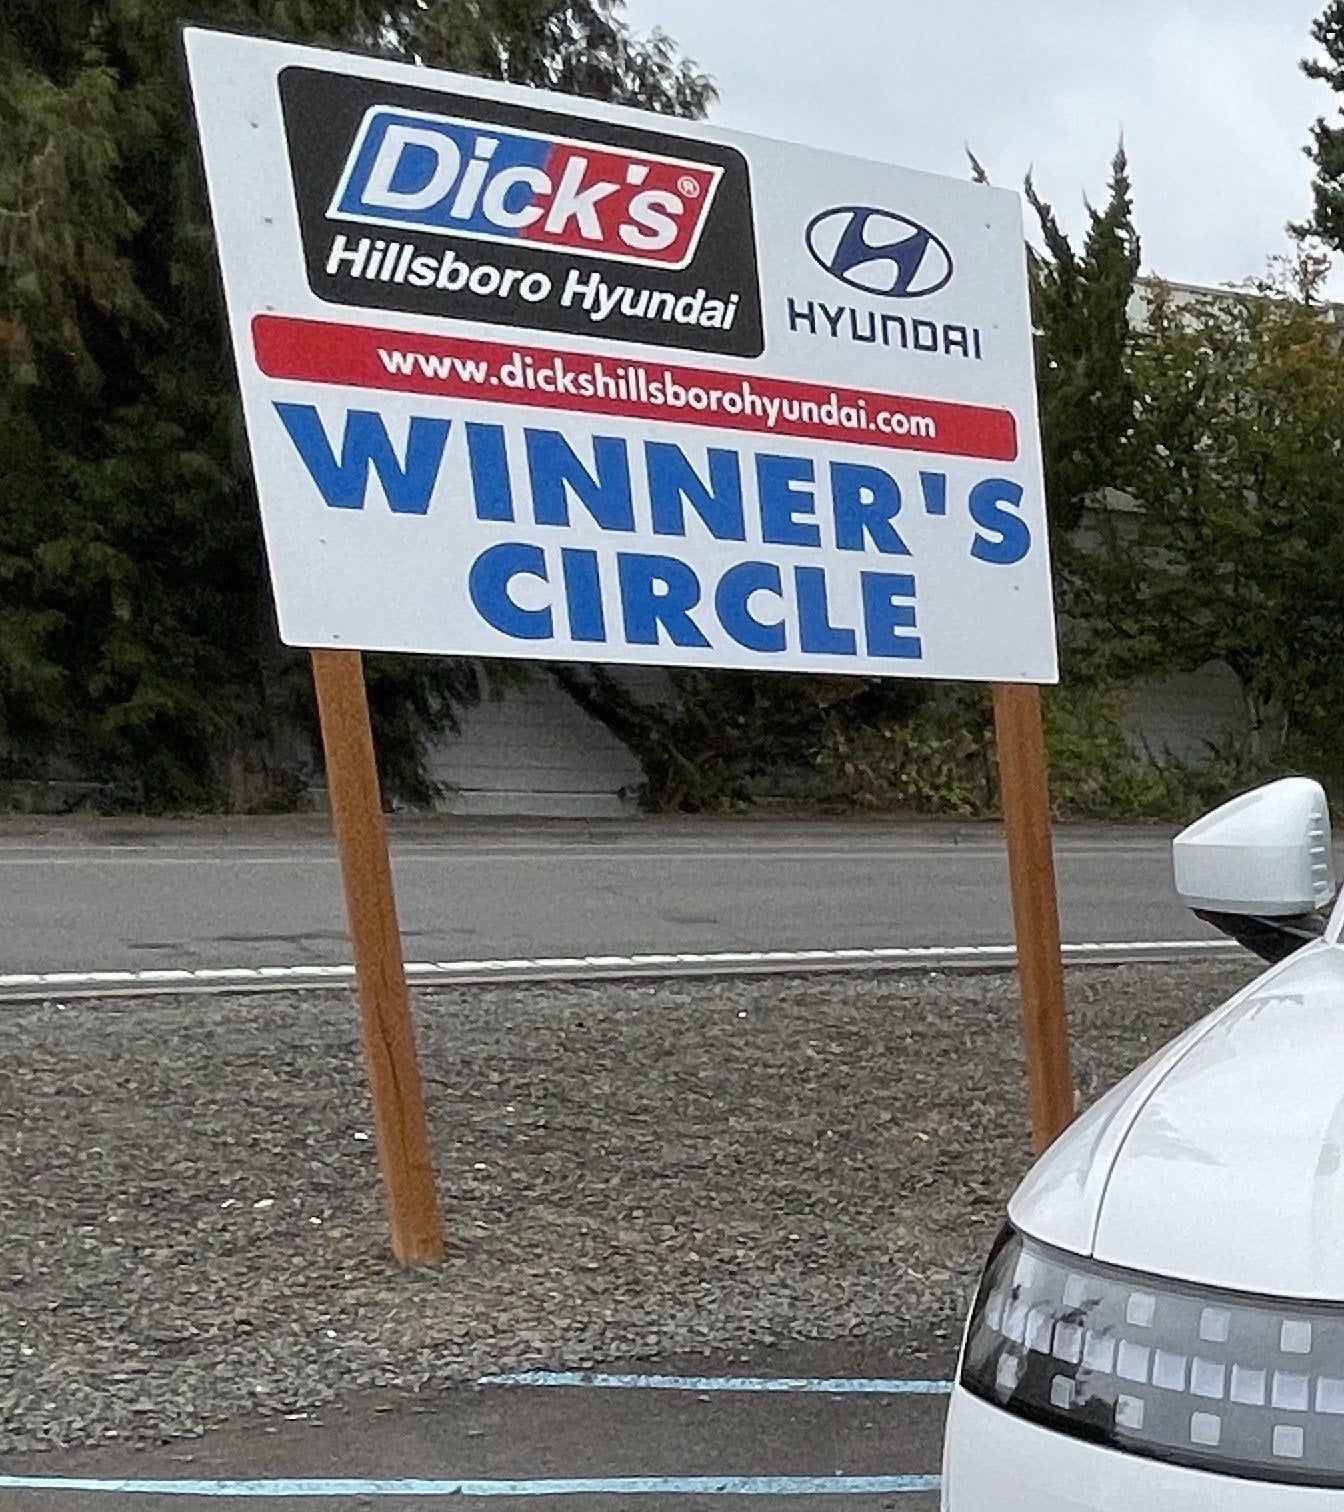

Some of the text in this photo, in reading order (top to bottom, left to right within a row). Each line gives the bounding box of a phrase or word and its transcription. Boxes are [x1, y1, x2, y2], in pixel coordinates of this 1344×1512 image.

[327, 236, 739, 329] Hillsboro Hyundai
[788, 298, 983, 361] HYUNDAI
[379, 349, 937, 438] www.dickshillsborohyundai.com
[271, 401, 1032, 565] WINNER'S
[468, 542, 923, 660] CIRCLE
